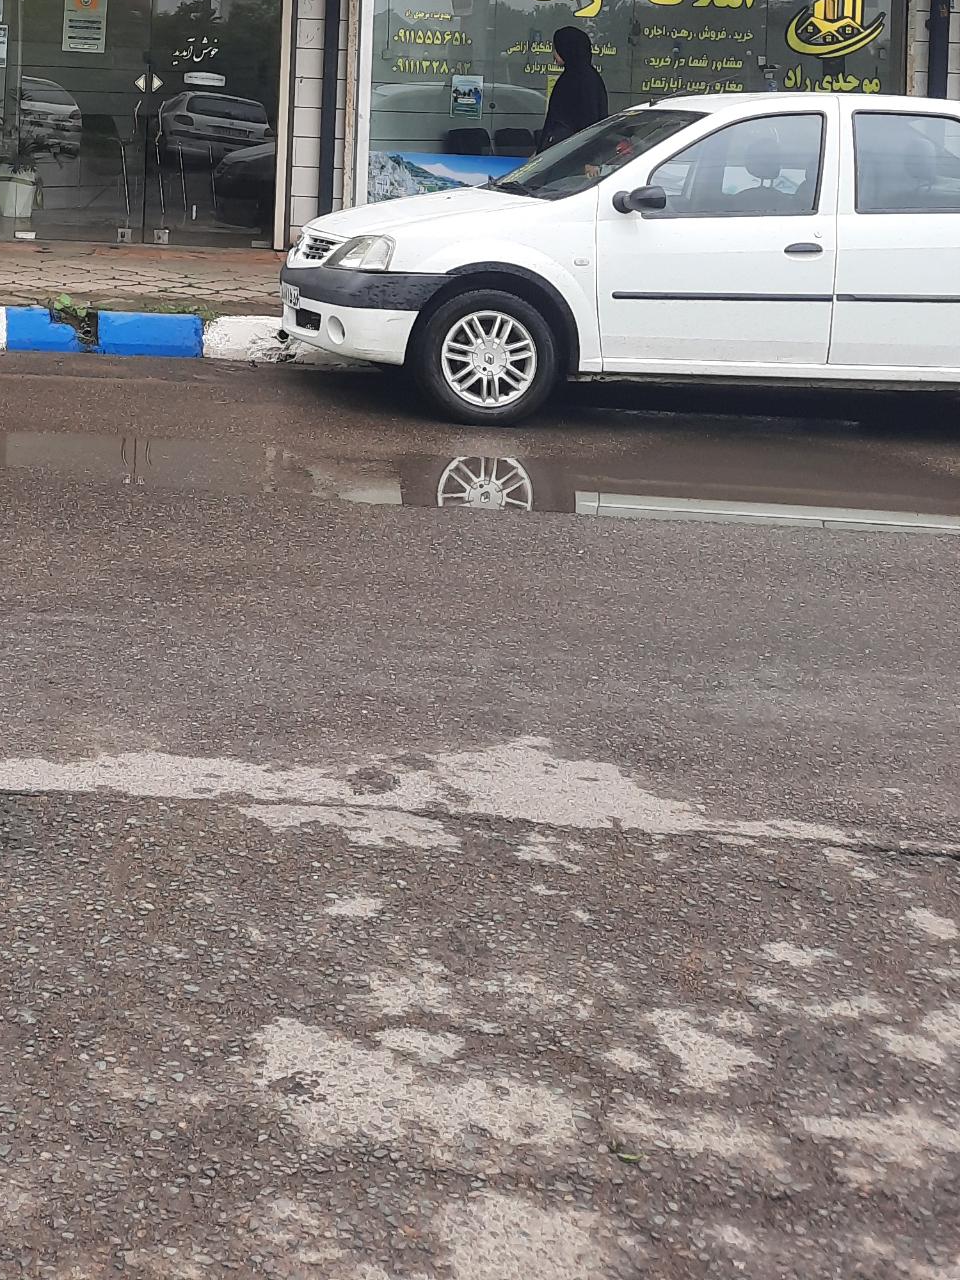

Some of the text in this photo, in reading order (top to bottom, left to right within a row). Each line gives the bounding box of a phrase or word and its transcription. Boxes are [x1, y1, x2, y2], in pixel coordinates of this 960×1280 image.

[172, 36, 219, 65] خوش آمدید
[673, 57, 685, 69] در
[688, 54, 709, 67] شما
[712, 57, 743, 71] مشاور
[814, 73, 880, 94] موحدی
